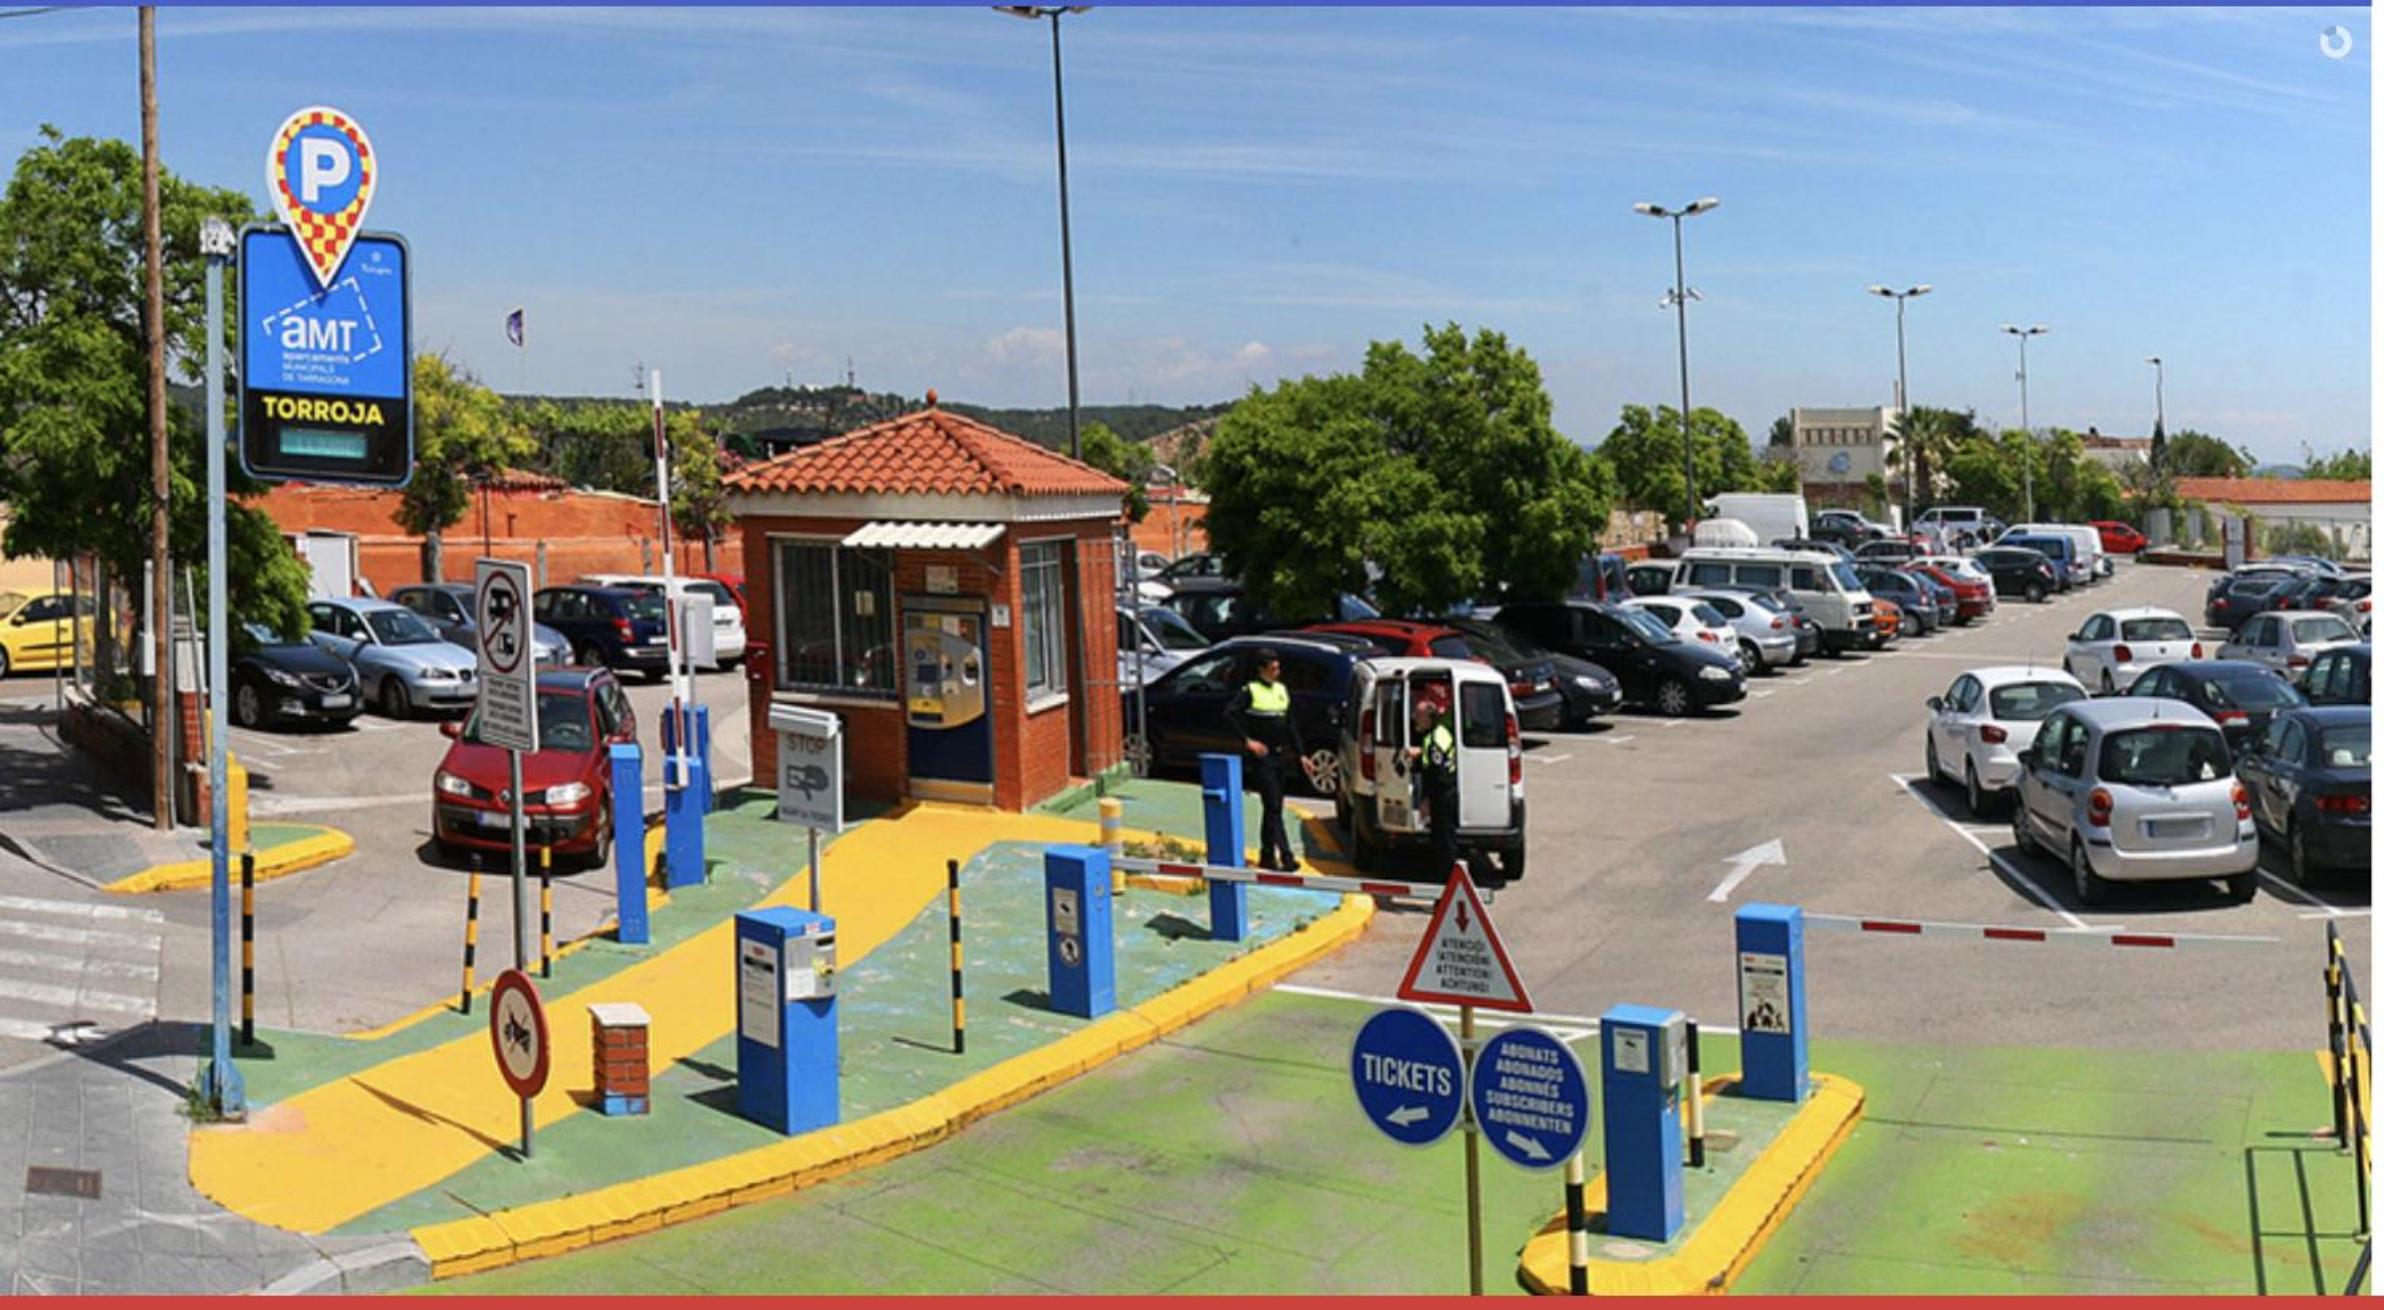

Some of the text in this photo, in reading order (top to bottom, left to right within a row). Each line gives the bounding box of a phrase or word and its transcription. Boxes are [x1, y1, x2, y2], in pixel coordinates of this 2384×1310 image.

[301, 138, 352, 202] P
[262, 395, 384, 426] TORROJA
[787, 732, 827, 755] STOP
[1501, 1042, 1559, 1065] ABONATS
[1361, 1053, 1452, 1097] TICKETS
[1496, 1058, 1565, 1083] ABONADOS
[1485, 1089, 1575, 1119] SUBSCRIBERS
[1488, 1107, 1572, 1135] ABONNENTEN
